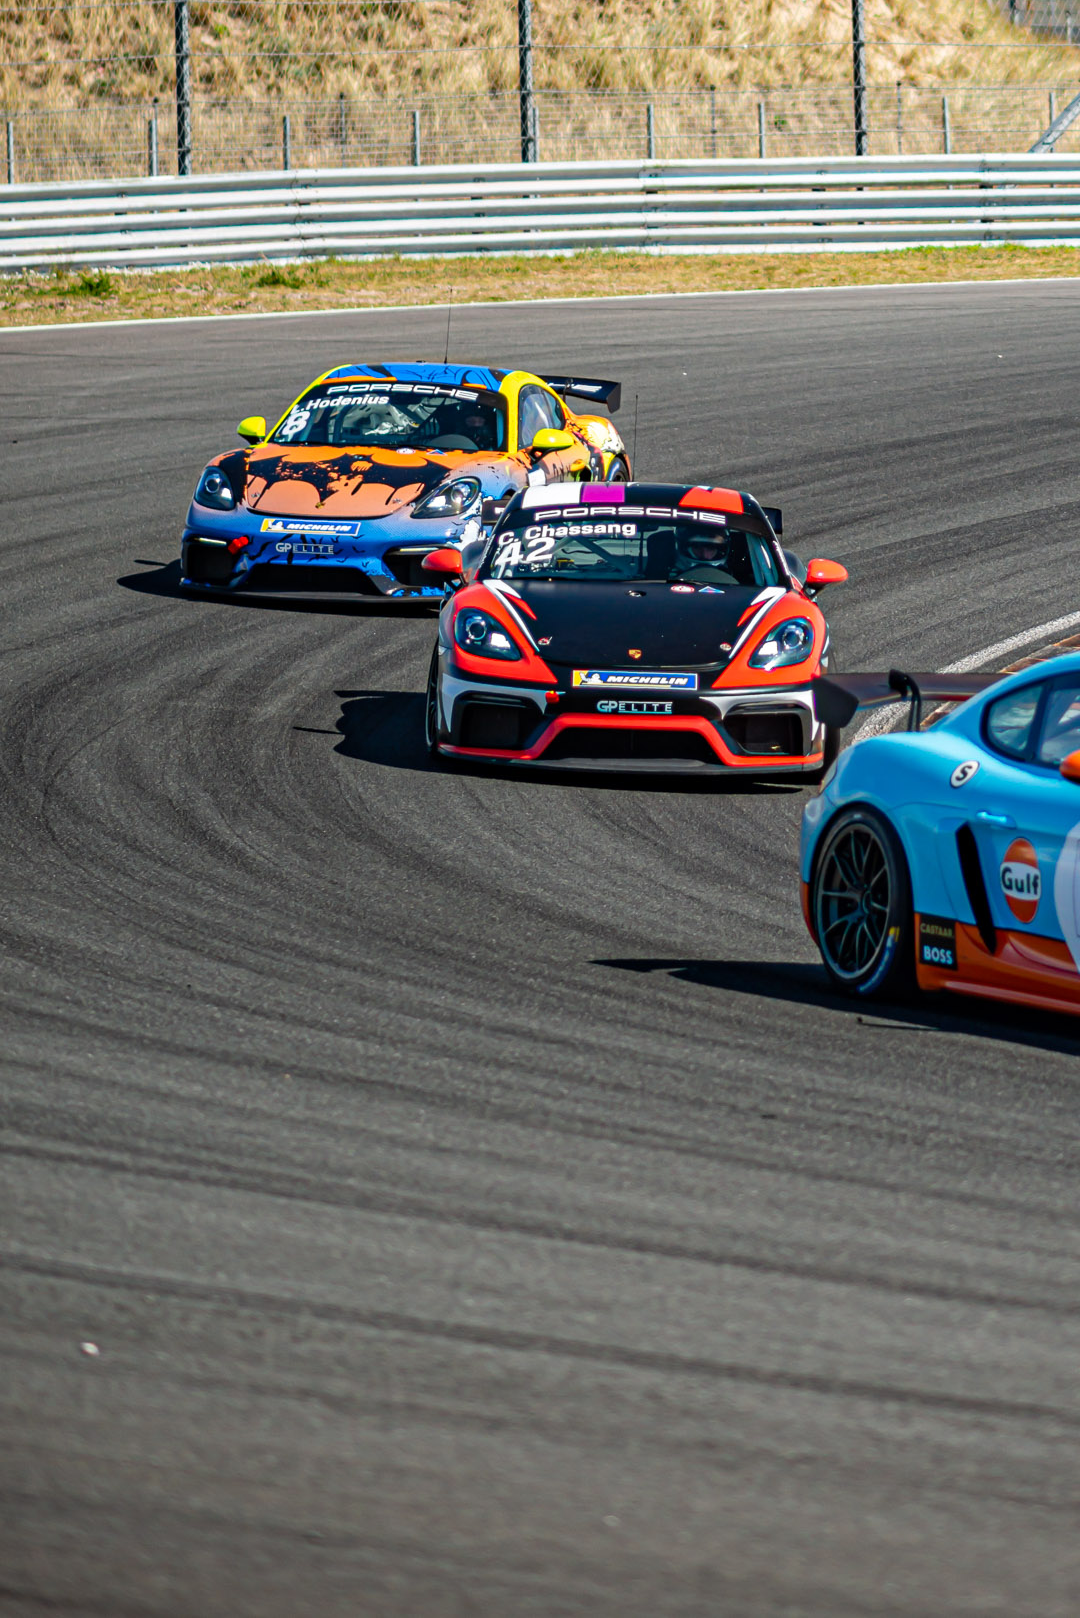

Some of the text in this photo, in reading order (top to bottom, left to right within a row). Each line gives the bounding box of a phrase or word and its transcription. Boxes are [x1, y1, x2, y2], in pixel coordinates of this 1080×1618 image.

[327, 383, 479, 401] PORSCHE
[281, 410, 311, 435] 8
[535, 506, 726, 525] PORSCHE
[286, 523, 352, 532] MICHELIN
[498, 523, 636, 545] C. Chassang
[495, 537, 556, 566] 42
[606, 675, 689, 685] MICHELIN
[1001, 866, 1040, 896] Gulf
[923, 944, 953, 965] BOSS
